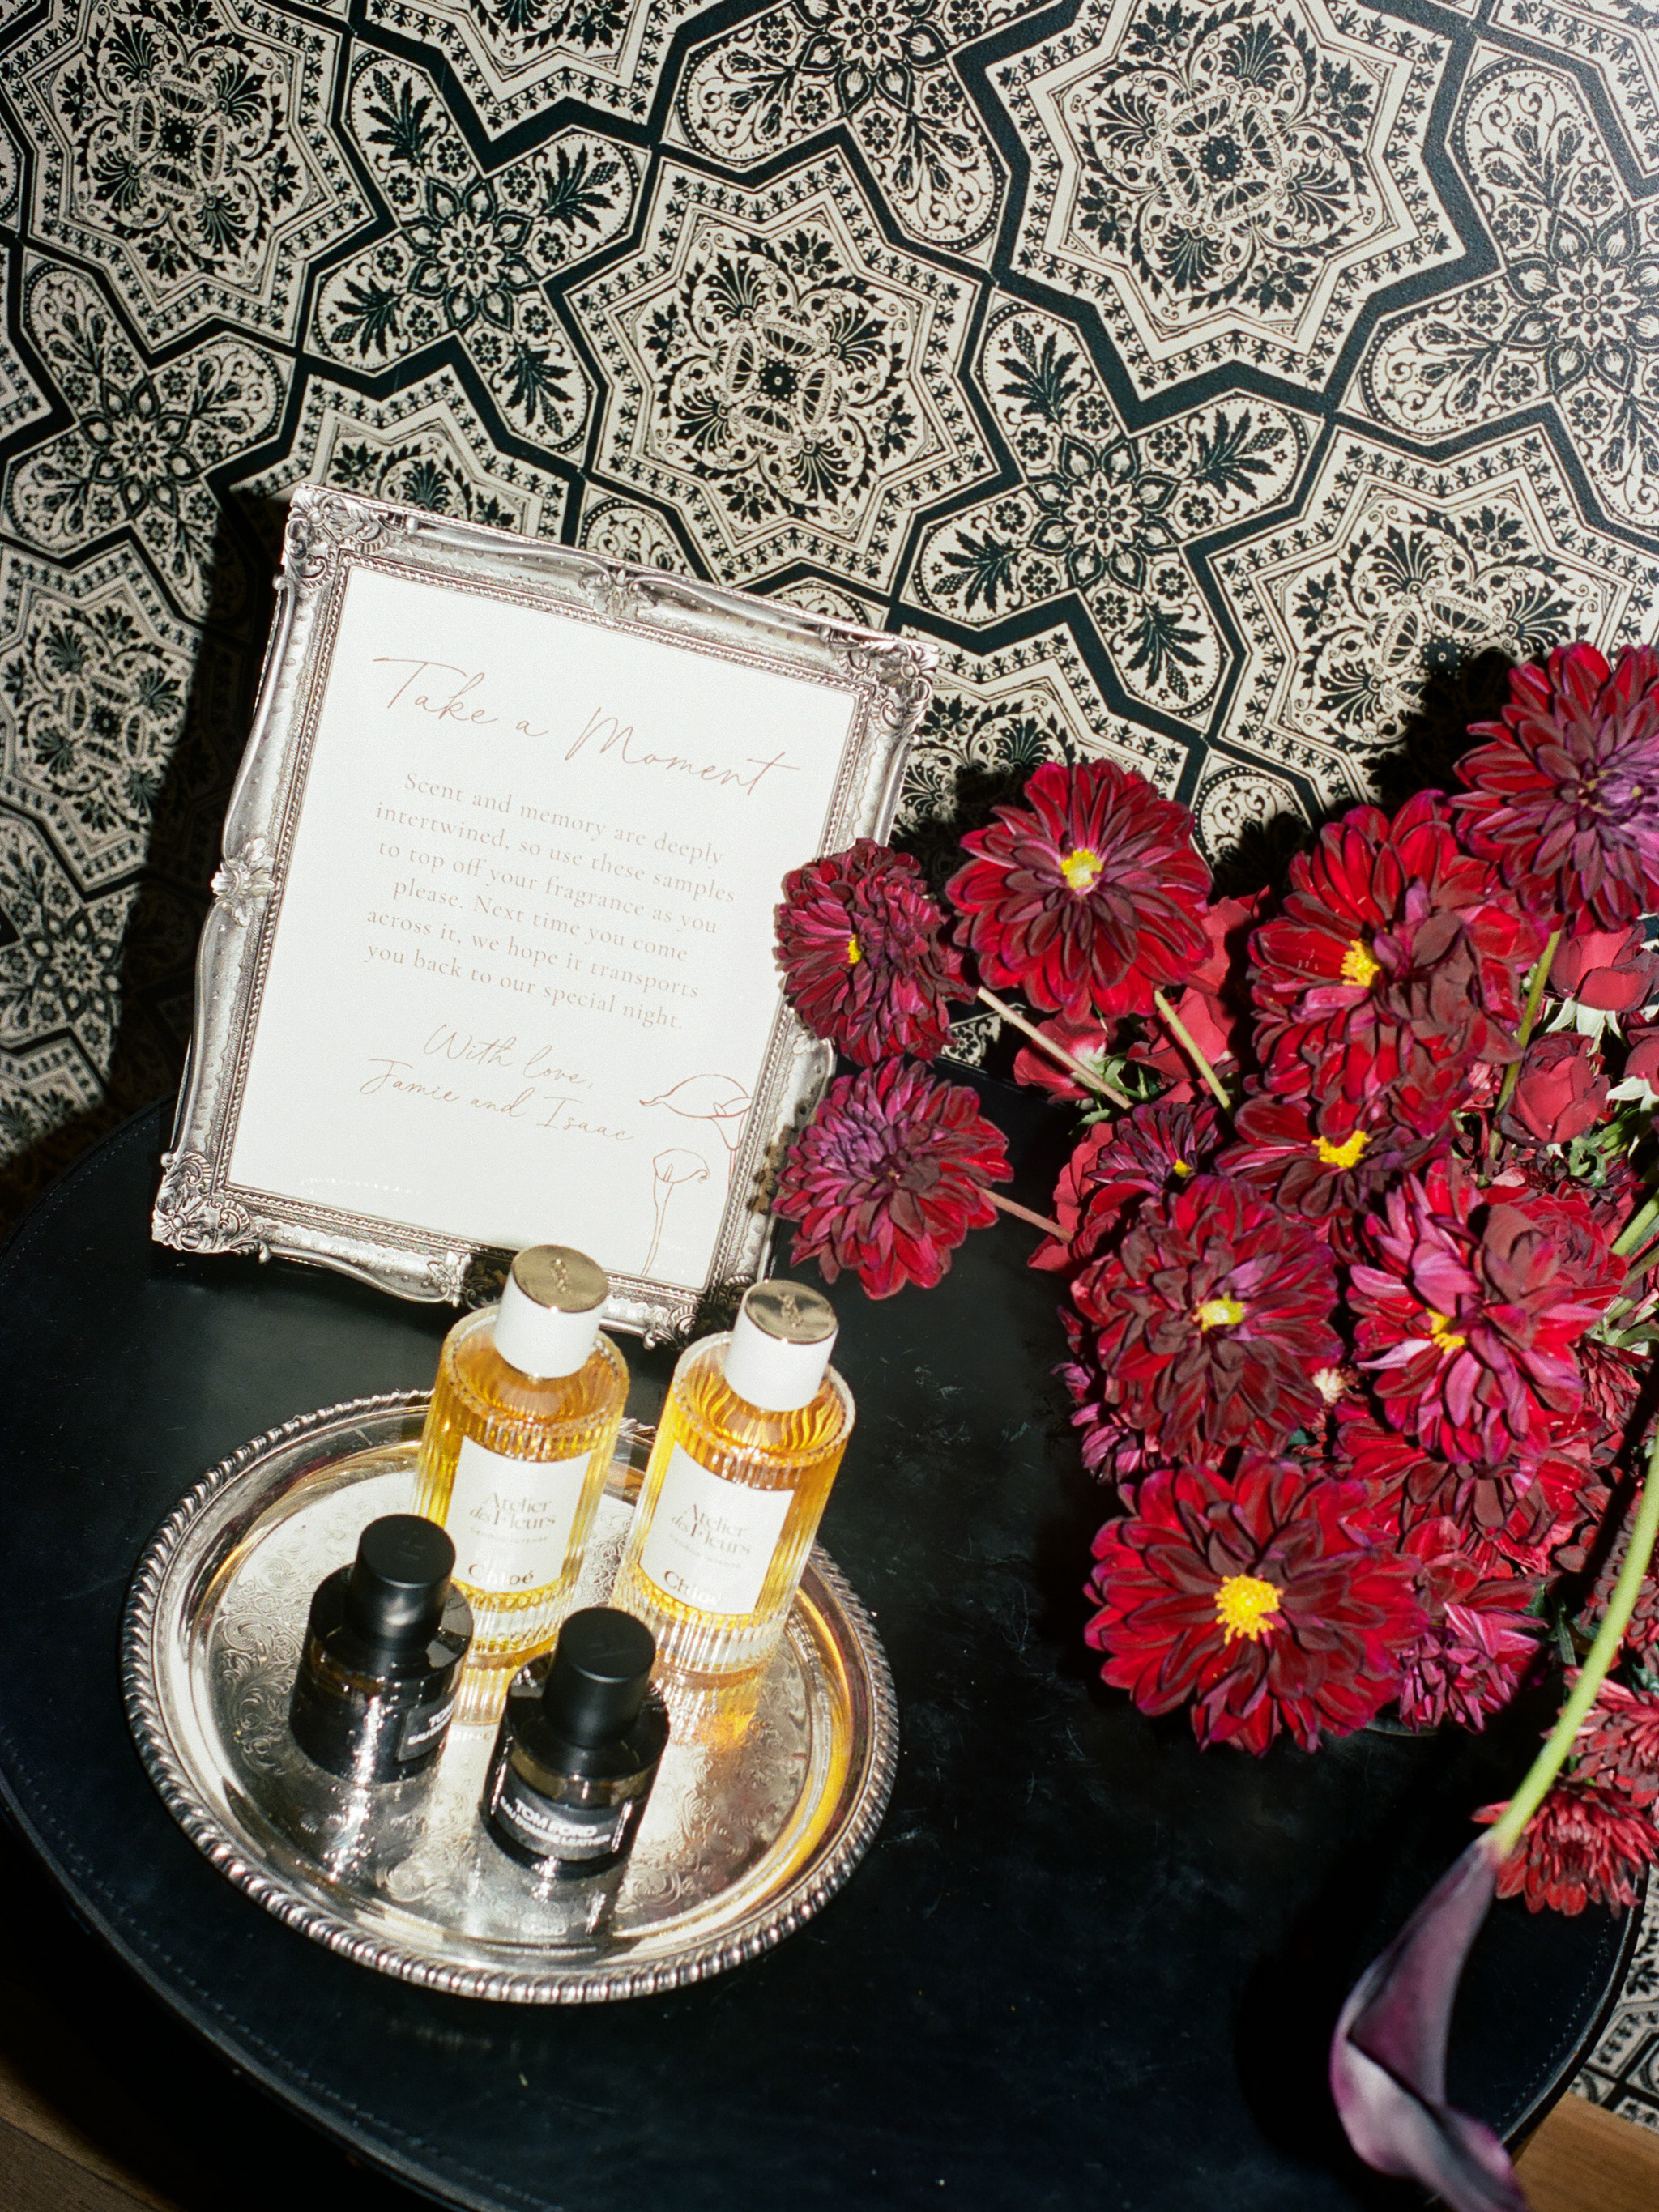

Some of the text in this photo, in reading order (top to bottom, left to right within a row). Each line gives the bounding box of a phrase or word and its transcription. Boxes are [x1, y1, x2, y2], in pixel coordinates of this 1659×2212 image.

[372, 657, 801, 796] Take a Moment
[376, 803, 736, 903] intertwined, so use these samples
[404, 772, 723, 867] Scent and memory are deeply
[378, 842, 718, 936] to top off your fragrance as you
[393, 877, 689, 962] please. Next time you come
[364, 944, 684, 1030] you back to our special night.
[367, 911, 698, 999] across it, we hope it transports
[424, 1024, 594, 1089] With love,
[360, 1058, 635, 1140] Jamie and Isaac
[481, 1492, 552, 1514] Atelier
[492, 1510, 556, 1530] Fleurs
[684, 1504, 748, 1538] Atelier
[691, 1523, 750, 1554] Fleurs
[515, 1797, 548, 1829] TOM
